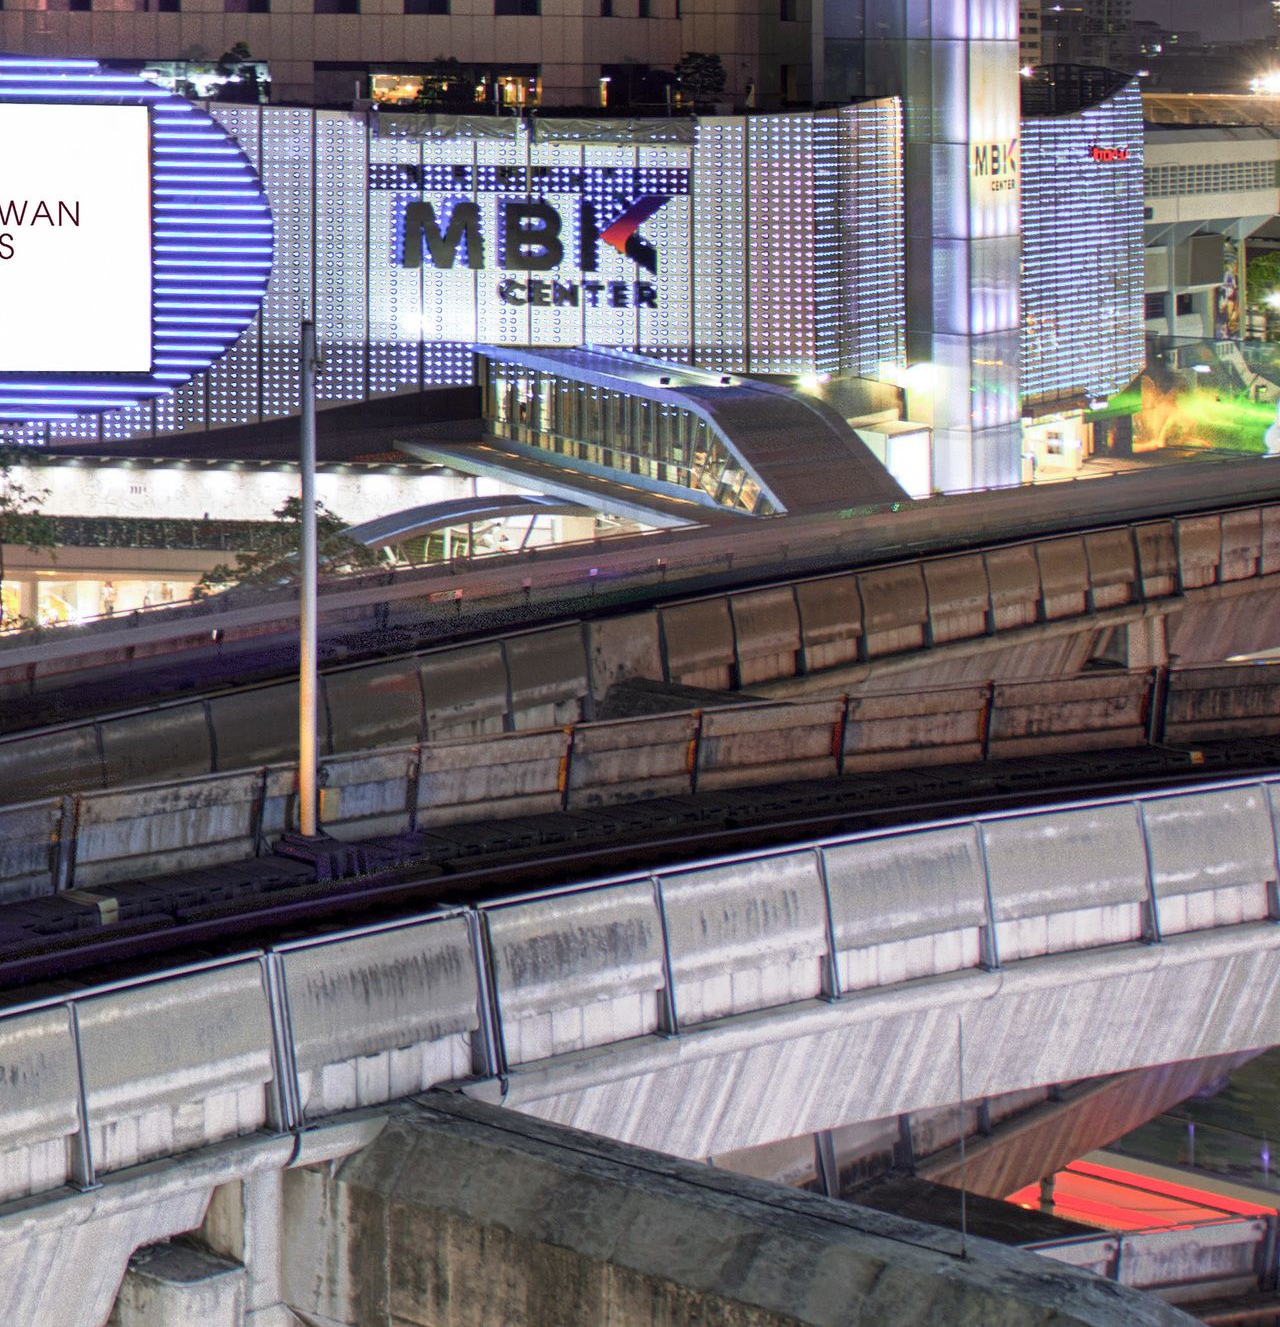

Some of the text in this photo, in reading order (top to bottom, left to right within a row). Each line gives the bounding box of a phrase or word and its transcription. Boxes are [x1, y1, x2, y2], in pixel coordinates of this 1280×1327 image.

[975, 138, 1017, 176] MBK
[992, 179, 1015, 191] CENTER
[395, 195, 672, 275] MBK
[498, 278, 658, 309] CENTER
